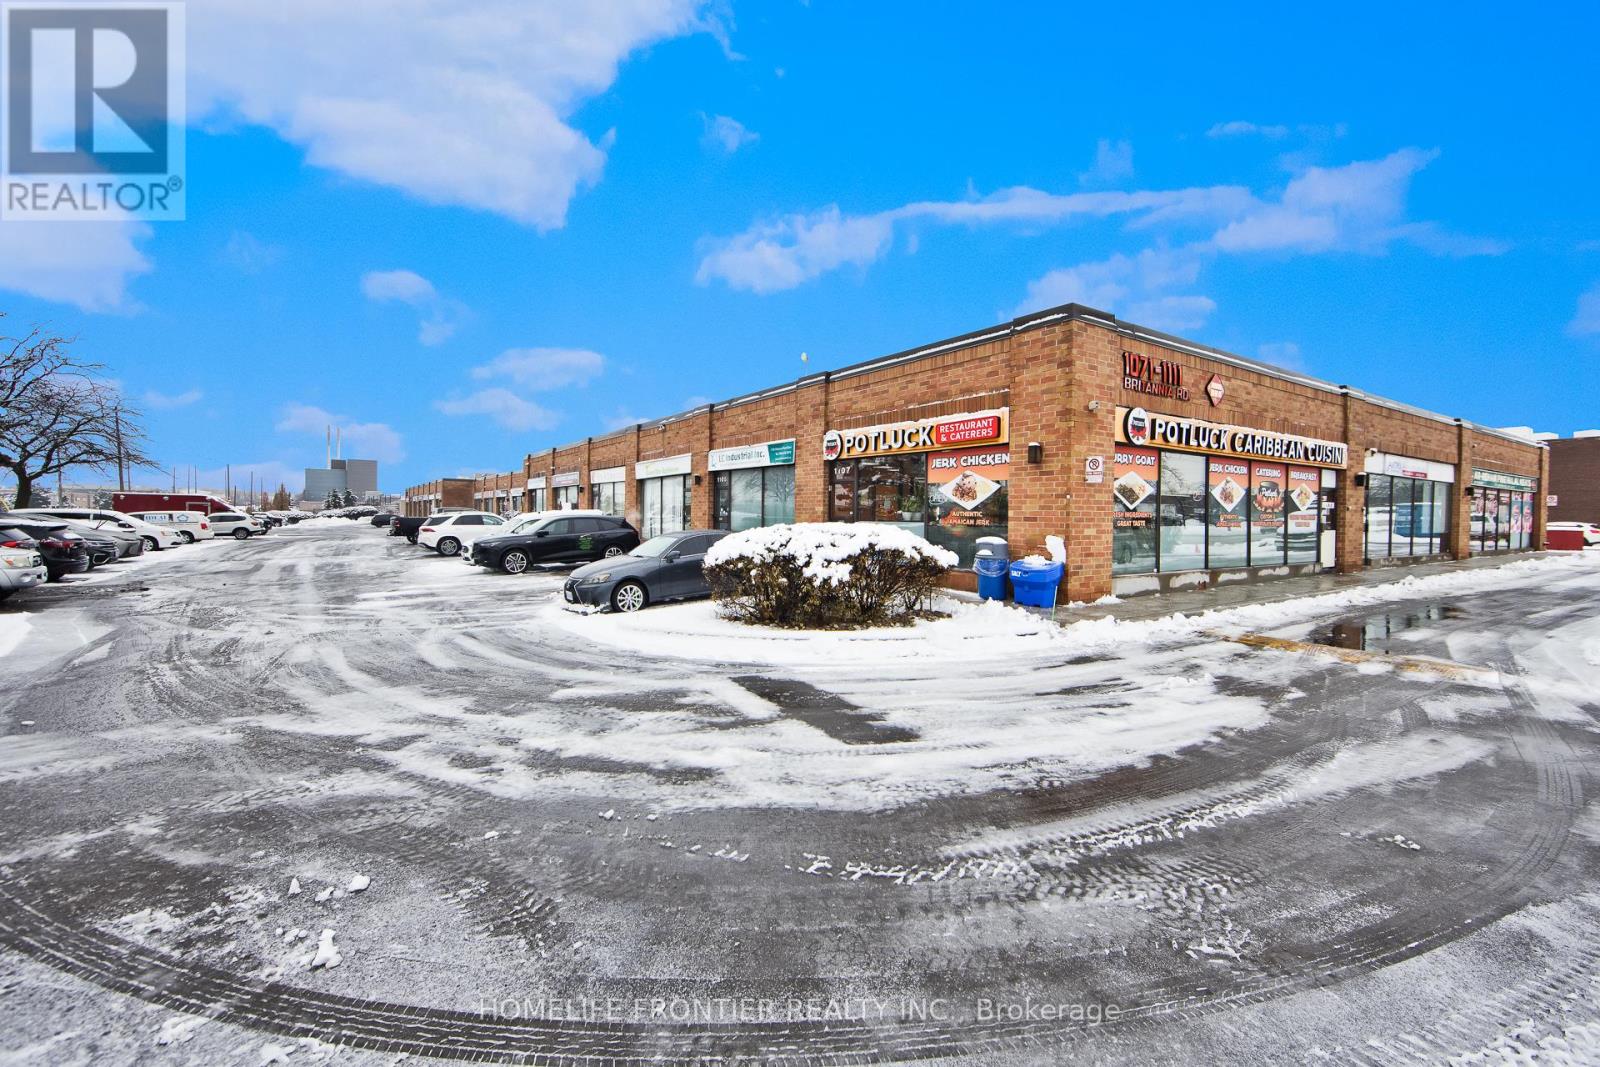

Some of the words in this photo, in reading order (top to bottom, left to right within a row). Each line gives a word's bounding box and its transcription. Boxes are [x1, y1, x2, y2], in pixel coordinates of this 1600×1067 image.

[1123, 377, 1173, 399] BRITANNIA
[939, 418, 994, 433] RESTAURANT
[940, 433, 948, 442] &
[949, 427, 993, 441] CATERERS
[844, 425, 934, 453] POTLUCK
[1153, 417, 1230, 450] POTLUCK
[1233, 432, 1305, 460] CARIBBEAN
[931, 456, 958, 470] JERK
[960, 452, 1010, 467] CHICKEN
[1135, 455, 1156, 466] GOAT
